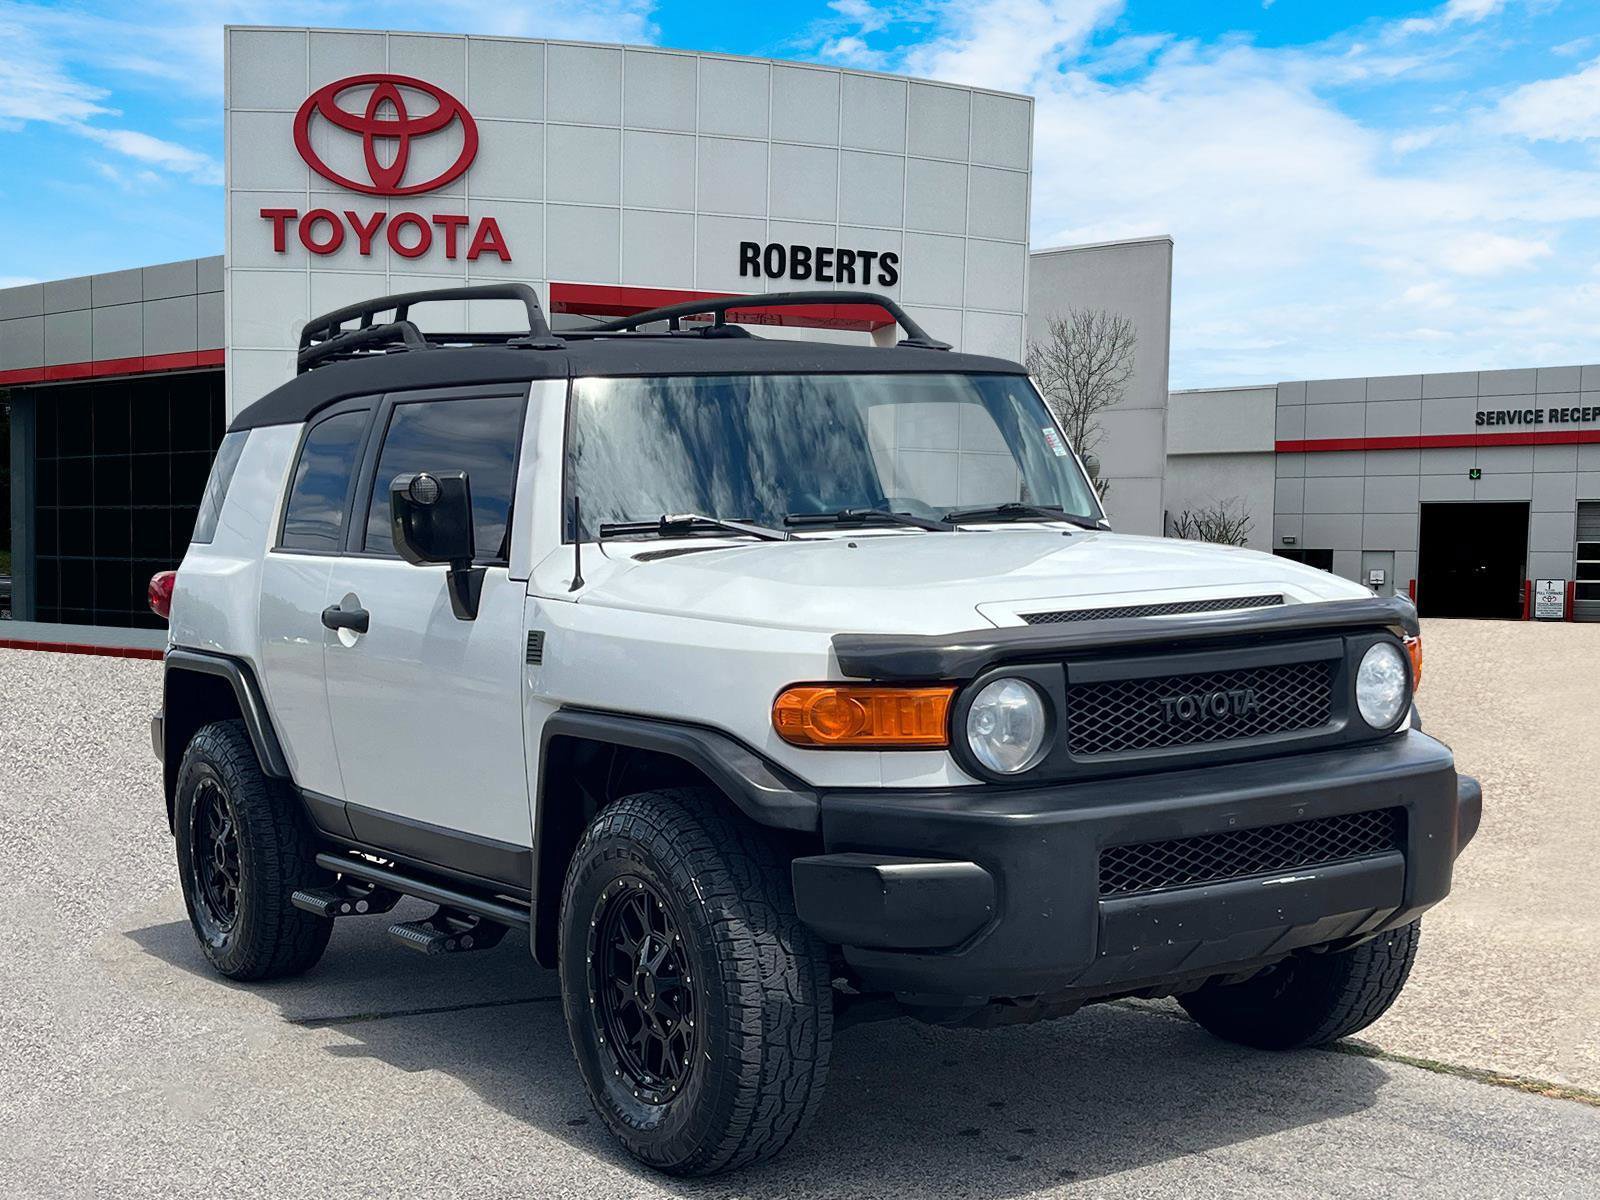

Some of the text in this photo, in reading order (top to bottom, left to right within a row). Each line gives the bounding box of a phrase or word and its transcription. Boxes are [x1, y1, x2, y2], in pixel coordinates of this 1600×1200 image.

[260, 209, 512, 262] TOYOTA
[739, 241, 899, 287] ROBERTS
[1475, 407, 1600, 426] SERVICE RECEP
[1159, 689, 1260, 722] TOYOTA
